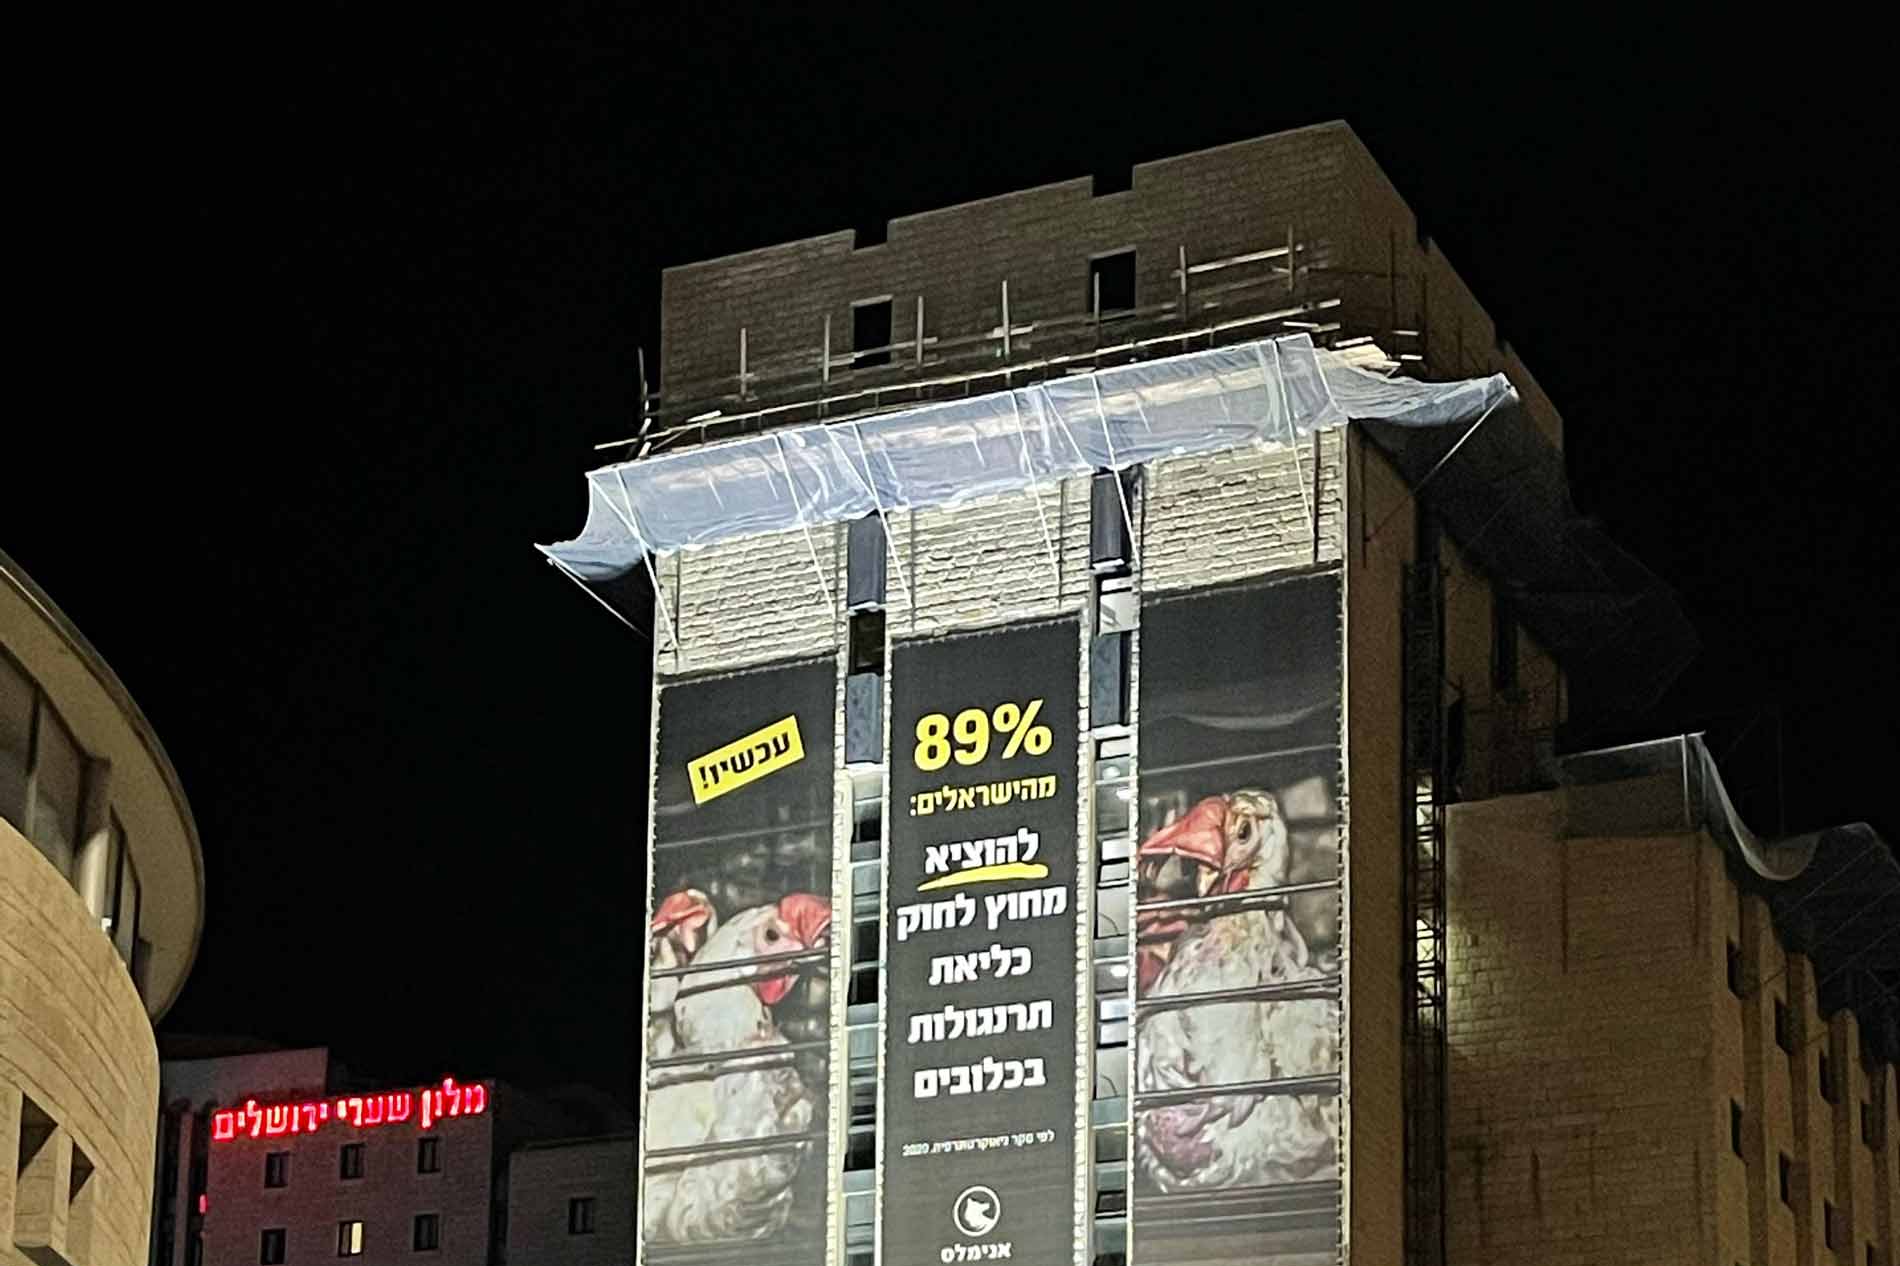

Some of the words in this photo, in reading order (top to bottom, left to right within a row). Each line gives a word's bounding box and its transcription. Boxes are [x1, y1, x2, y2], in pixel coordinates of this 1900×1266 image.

[914, 700, 1053, 772] 89%
[699, 729, 791, 791] עכשיו!
[909, 774, 1057, 818] מהישראלים:
[924, 827, 1041, 874] להוציא
[896, 891, 977, 942] לחוק
[983, 885, 1068, 932] מחוץ
[928, 947, 1033, 987] כליאת
[908, 999, 1053, 1046] תרנגולות
[913, 1055, 1047, 1100] בכלובים
[211, 1098, 330, 1142] ירושלים
[335, 1093, 412, 1128] שערי
[419, 1076, 489, 1130] מלון
[1037, 1129, 1055, 1143] לפי
[940, 1240, 1013, 1264] אנימלס
